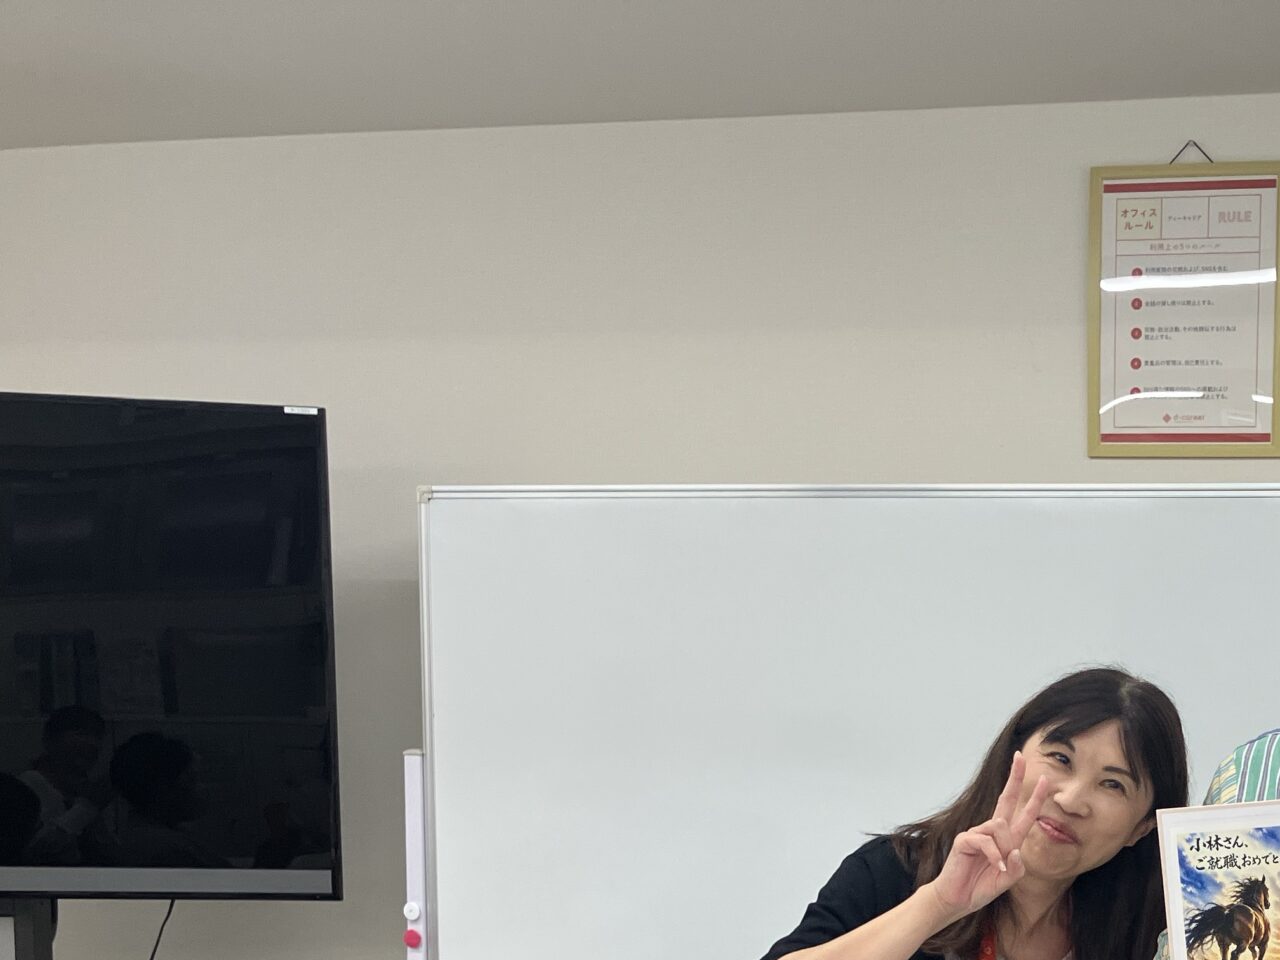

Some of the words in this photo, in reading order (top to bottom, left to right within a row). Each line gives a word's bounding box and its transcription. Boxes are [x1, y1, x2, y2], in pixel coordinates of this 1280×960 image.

[1121, 208, 1157, 218] オフィス
[1218, 211, 1252, 223] RULE
[1124, 221, 1154, 230] ルール
[1189, 834, 1249, 853] 小林さん、
